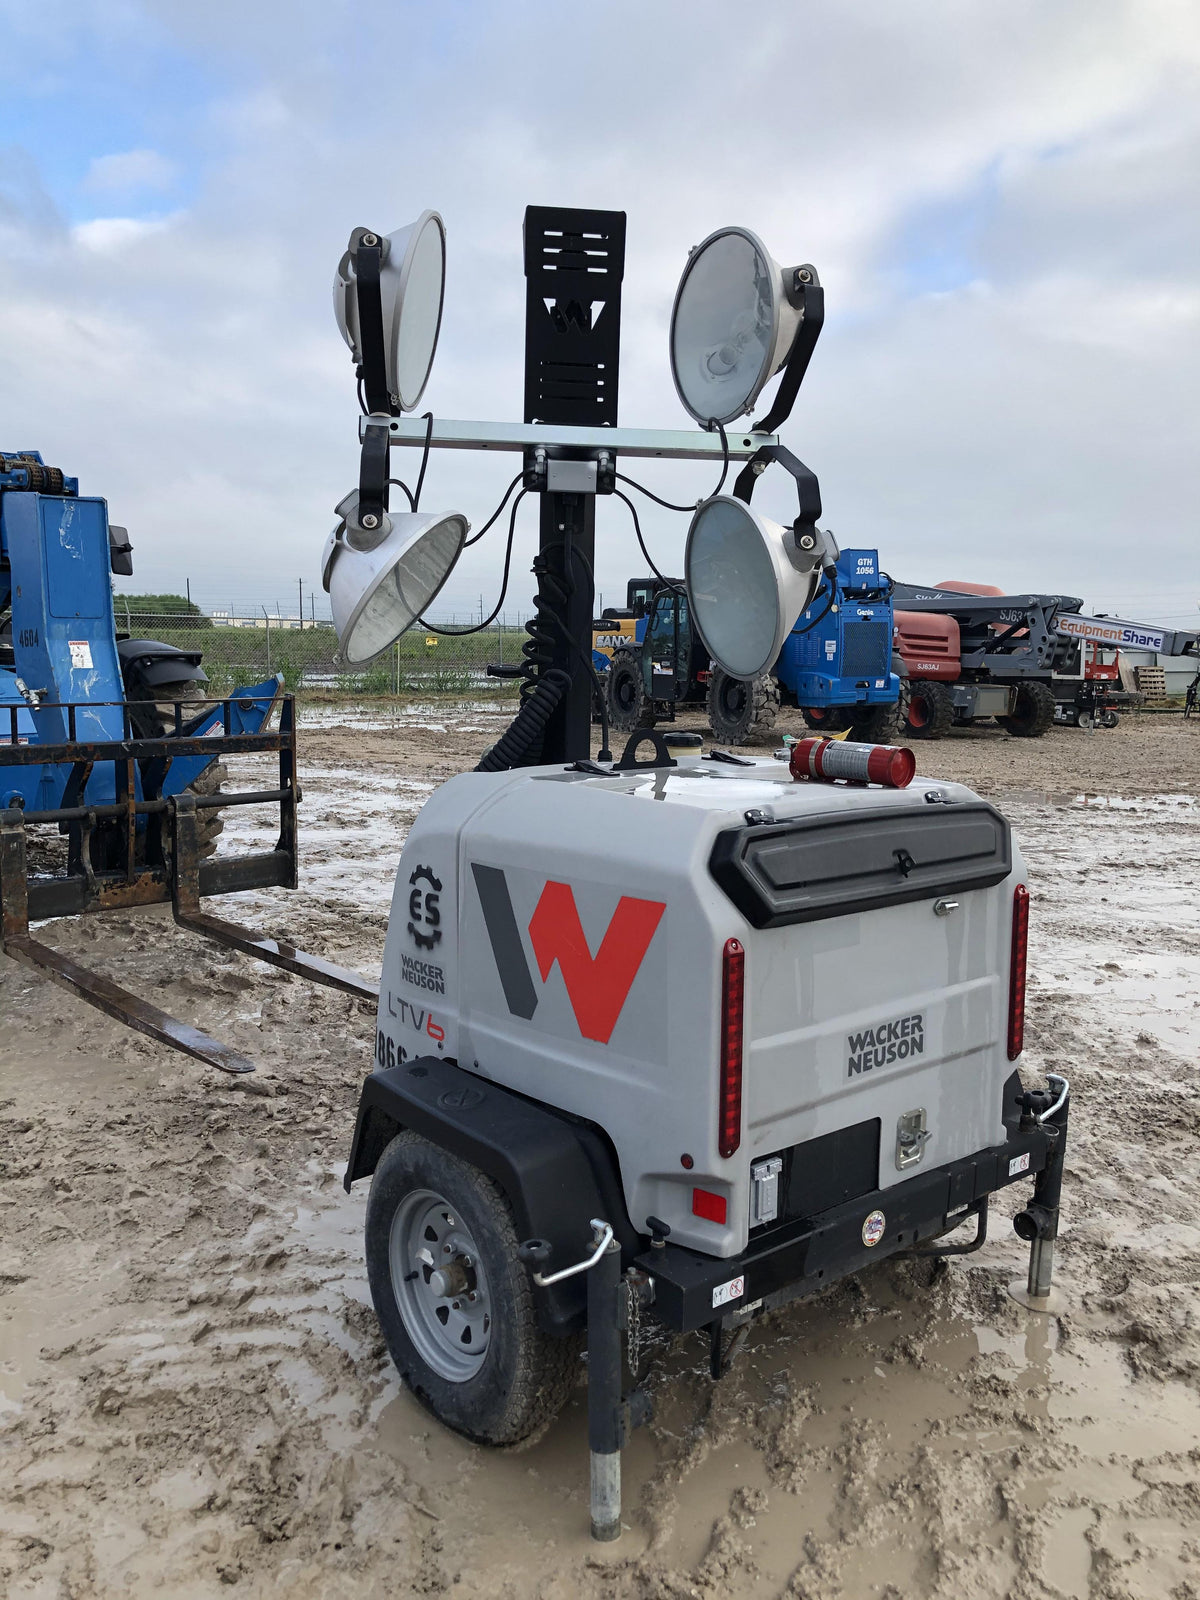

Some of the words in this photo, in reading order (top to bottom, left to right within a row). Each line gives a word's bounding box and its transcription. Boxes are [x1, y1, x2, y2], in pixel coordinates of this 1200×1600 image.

[855, 566, 875, 575] 1056
[857, 558, 873, 567] GTH
[856, 608, 874, 616] Genie
[19, 627, 39, 648] 4604
[595, 635, 632, 649] SANY
[1060, 618, 1162, 648] EquipmentShare
[917, 663, 939, 671] SJ63AJ
[401, 953, 444, 981] WACKER
[402, 967, 445, 995] NEUSON
[388, 991, 445, 1042] LTV6
[847, 1014, 924, 1055] WACKER
[847, 1033, 924, 1078] NEUSON
